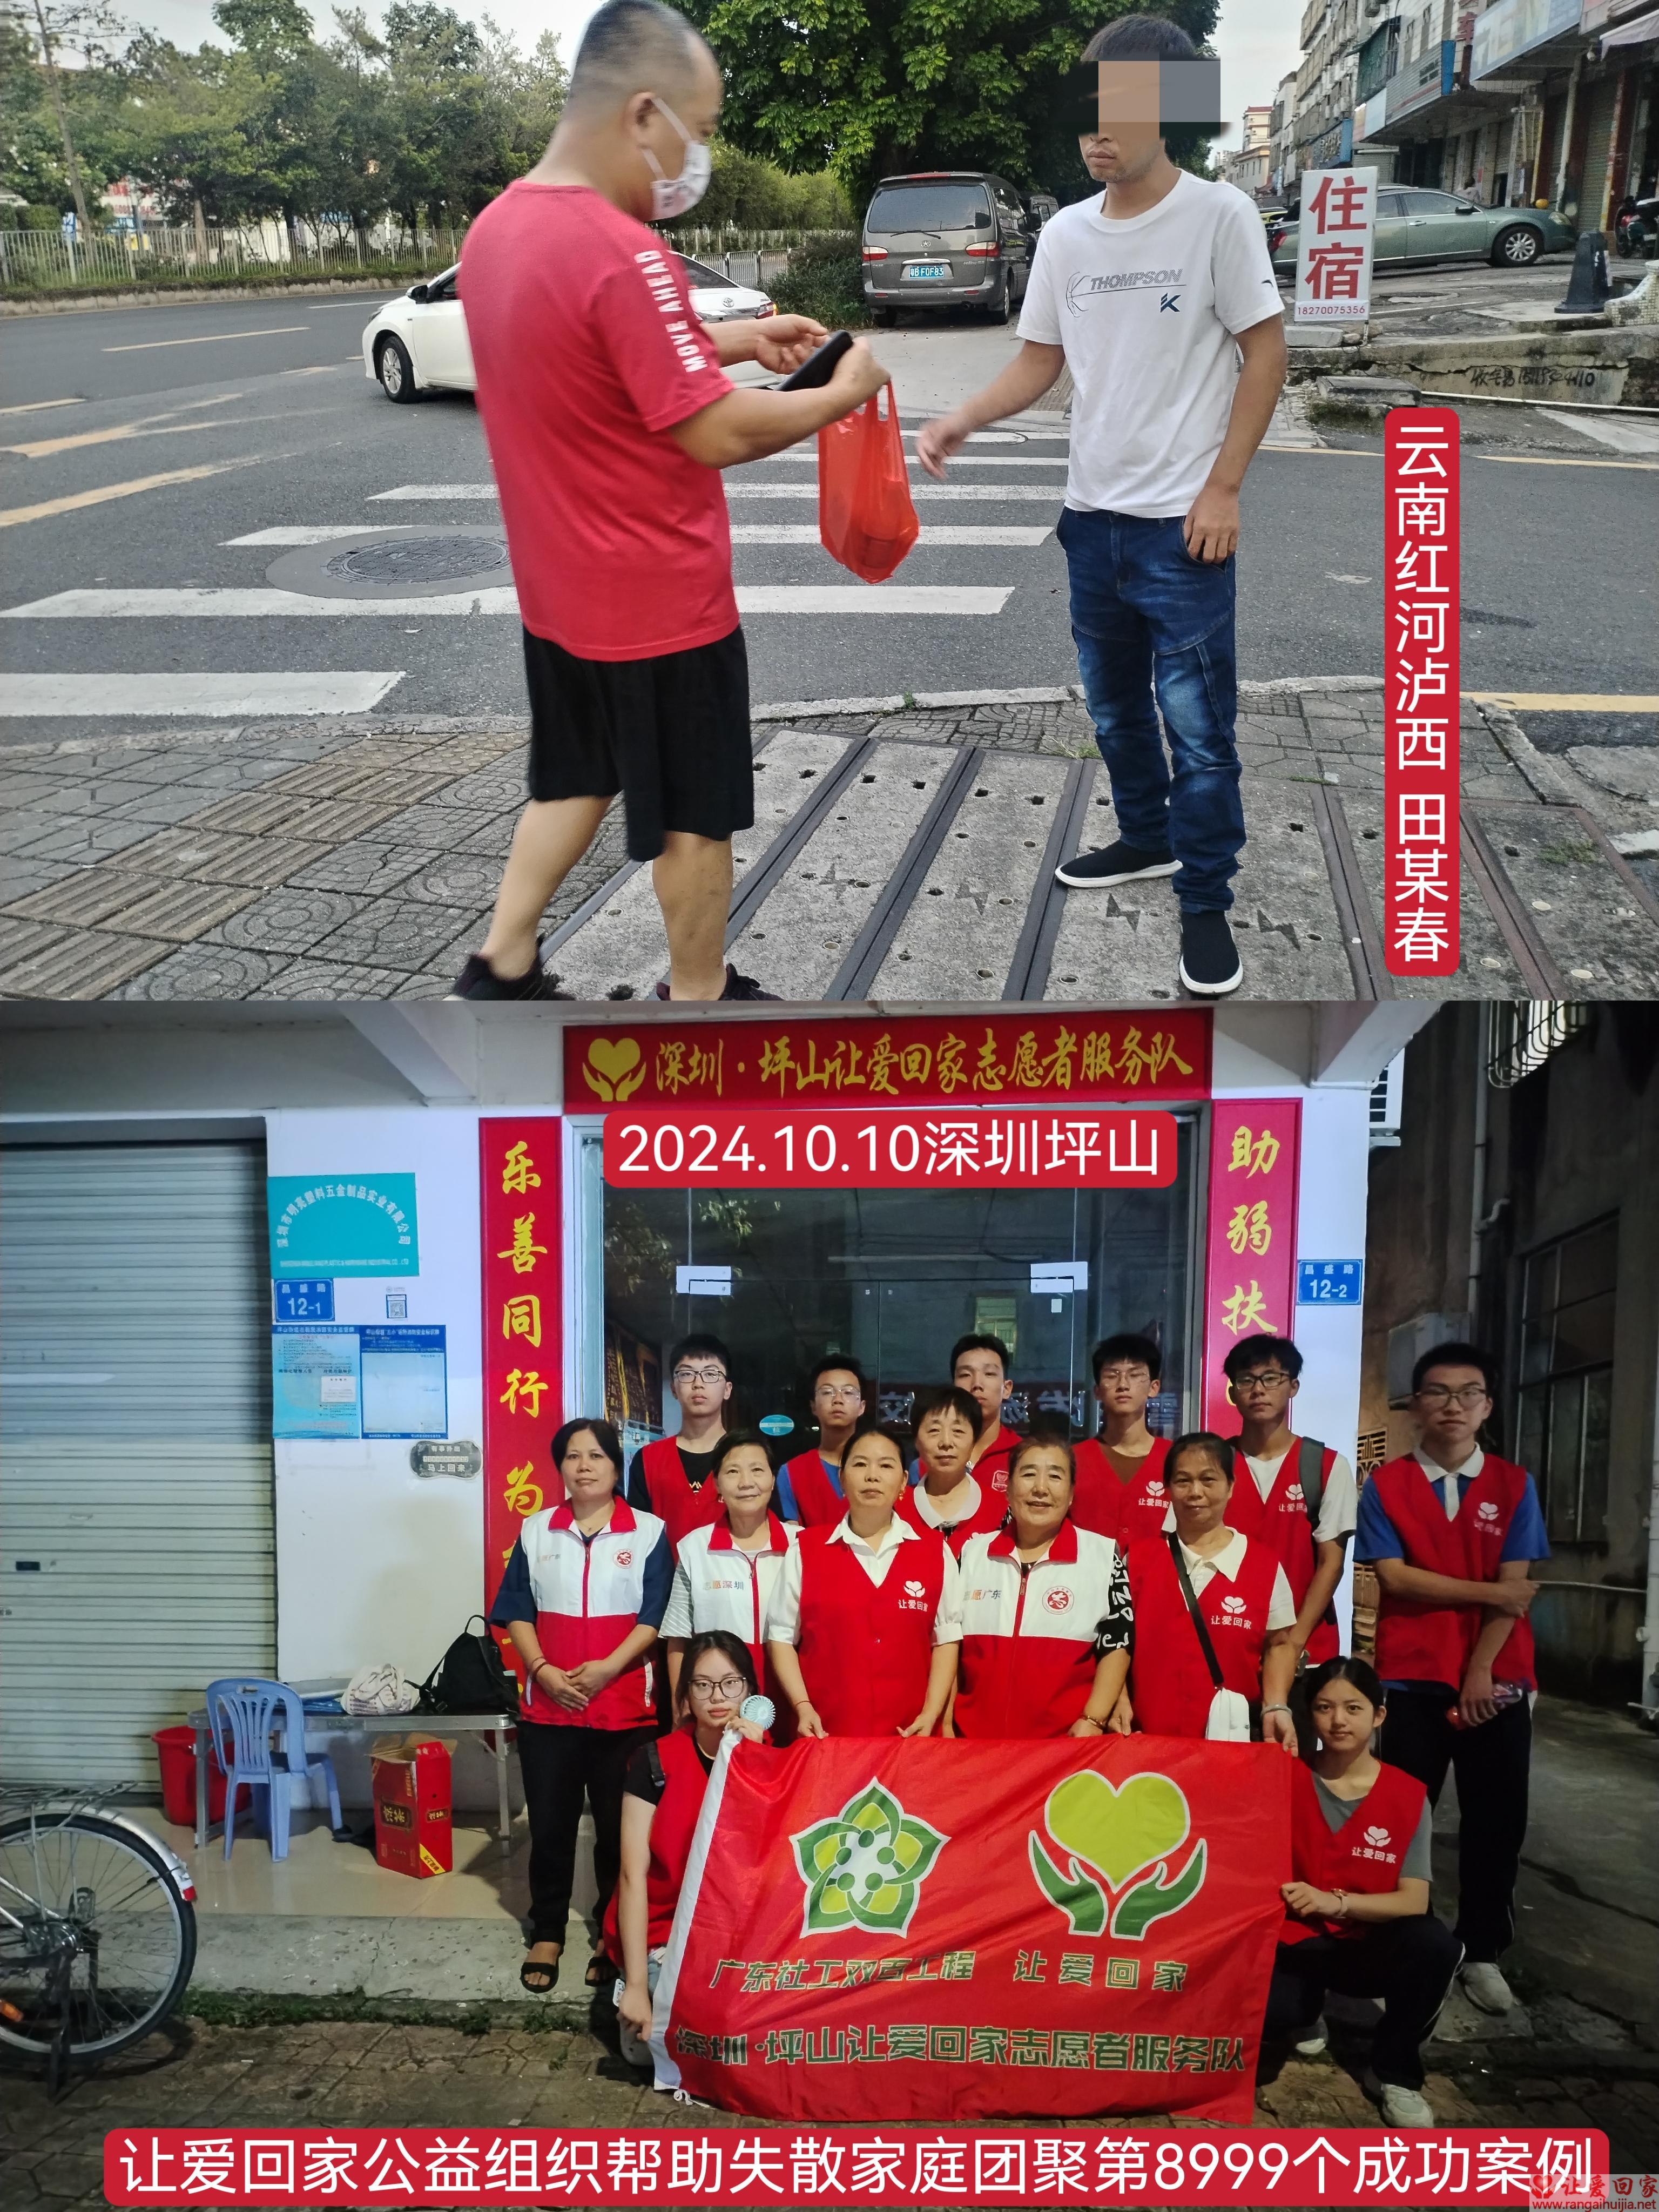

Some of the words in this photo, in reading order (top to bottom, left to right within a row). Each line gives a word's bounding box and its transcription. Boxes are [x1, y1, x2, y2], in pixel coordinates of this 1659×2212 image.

[1305, 176, 1367, 300] 住宿
[634, 250, 684, 312] AHEAD
[1090, 268, 1183, 291] THOMPSON
[1298, 306, 1365, 315] 18270075356
[665, 320, 708, 373] MOVE
[1222, 1125, 1280, 1405] 助弱扶
[1310, 1279, 1347, 1298] 12-2
[288, 1298, 321, 1316] 12-1
[1211, 1615, 1252, 1630] 让爱回家
[1352, 1846, 1397, 1864] 让爱回家
[1013, 1948, 1188, 1992] 让爱回家
